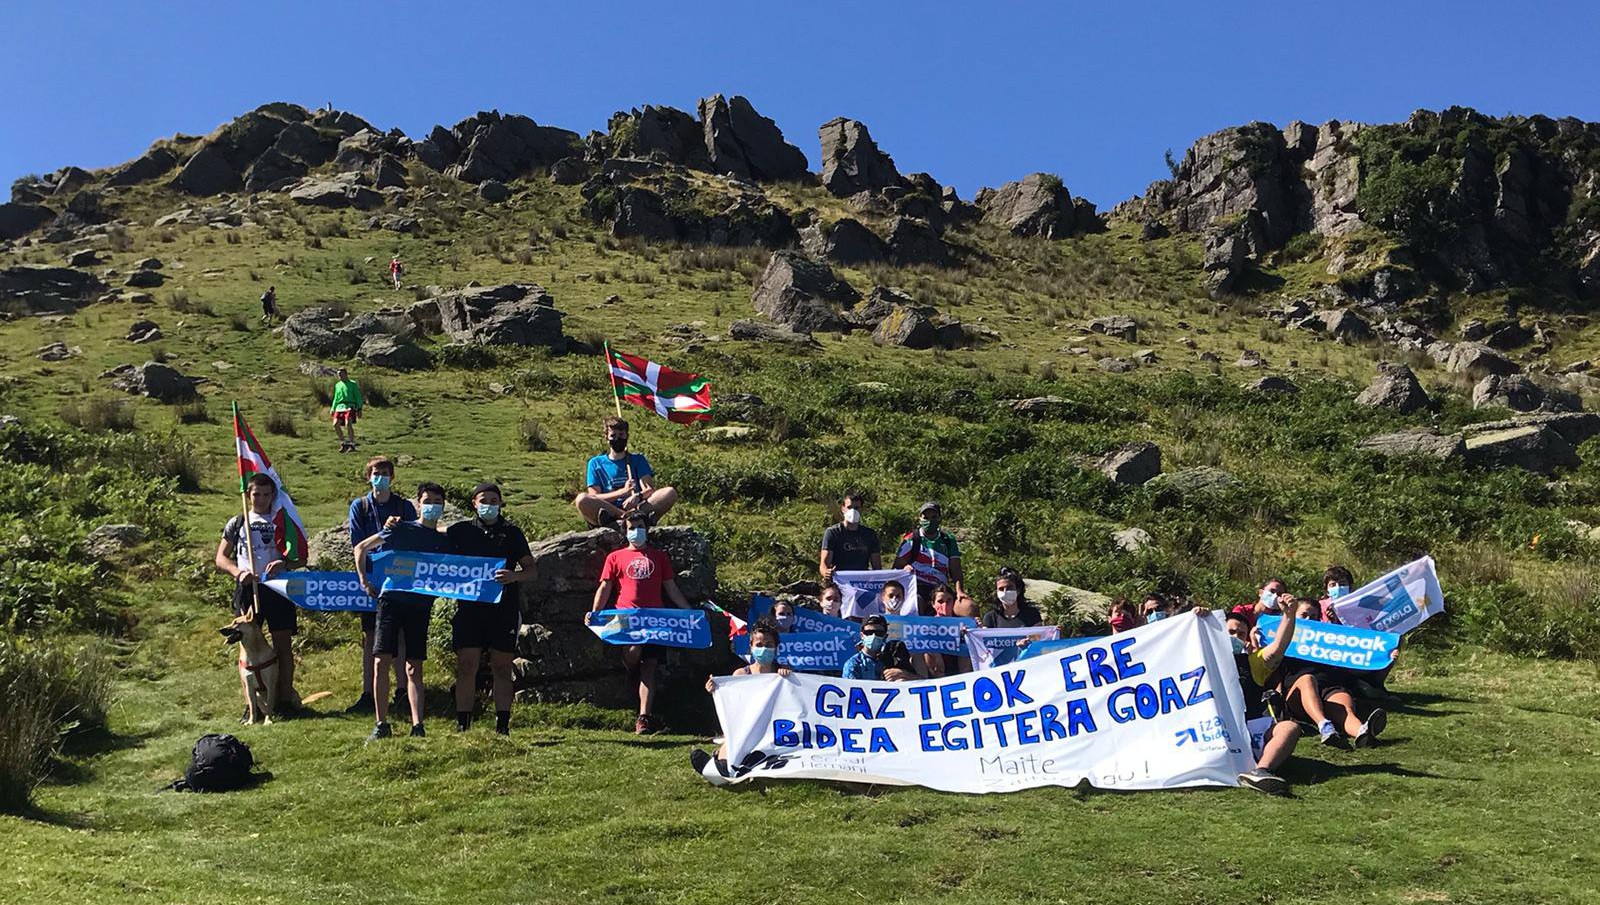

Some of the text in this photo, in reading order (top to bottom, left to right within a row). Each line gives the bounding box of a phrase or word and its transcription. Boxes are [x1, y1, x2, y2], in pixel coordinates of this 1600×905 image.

[415, 561, 495, 579] presoak
[305, 580, 366, 594] preso
[412, 577, 481, 596] etxera!
[305, 593, 373, 608] etxera!
[629, 614, 701, 630] presoak
[629, 628, 693, 644] etxera!
[777, 636, 847, 654] presoak
[904, 637, 960, 651] etxera!
[986, 638, 1016, 647] etxer
[1302, 628, 1387, 652] presoak
[777, 651, 839, 667] etxera!
[1297, 643, 1373, 667] etxera!
[1060, 637, 1146, 692] ERE
[773, 666, 1214, 753] BIDEA EGITERA GOAZ
[980, 753, 1058, 775] Maite
